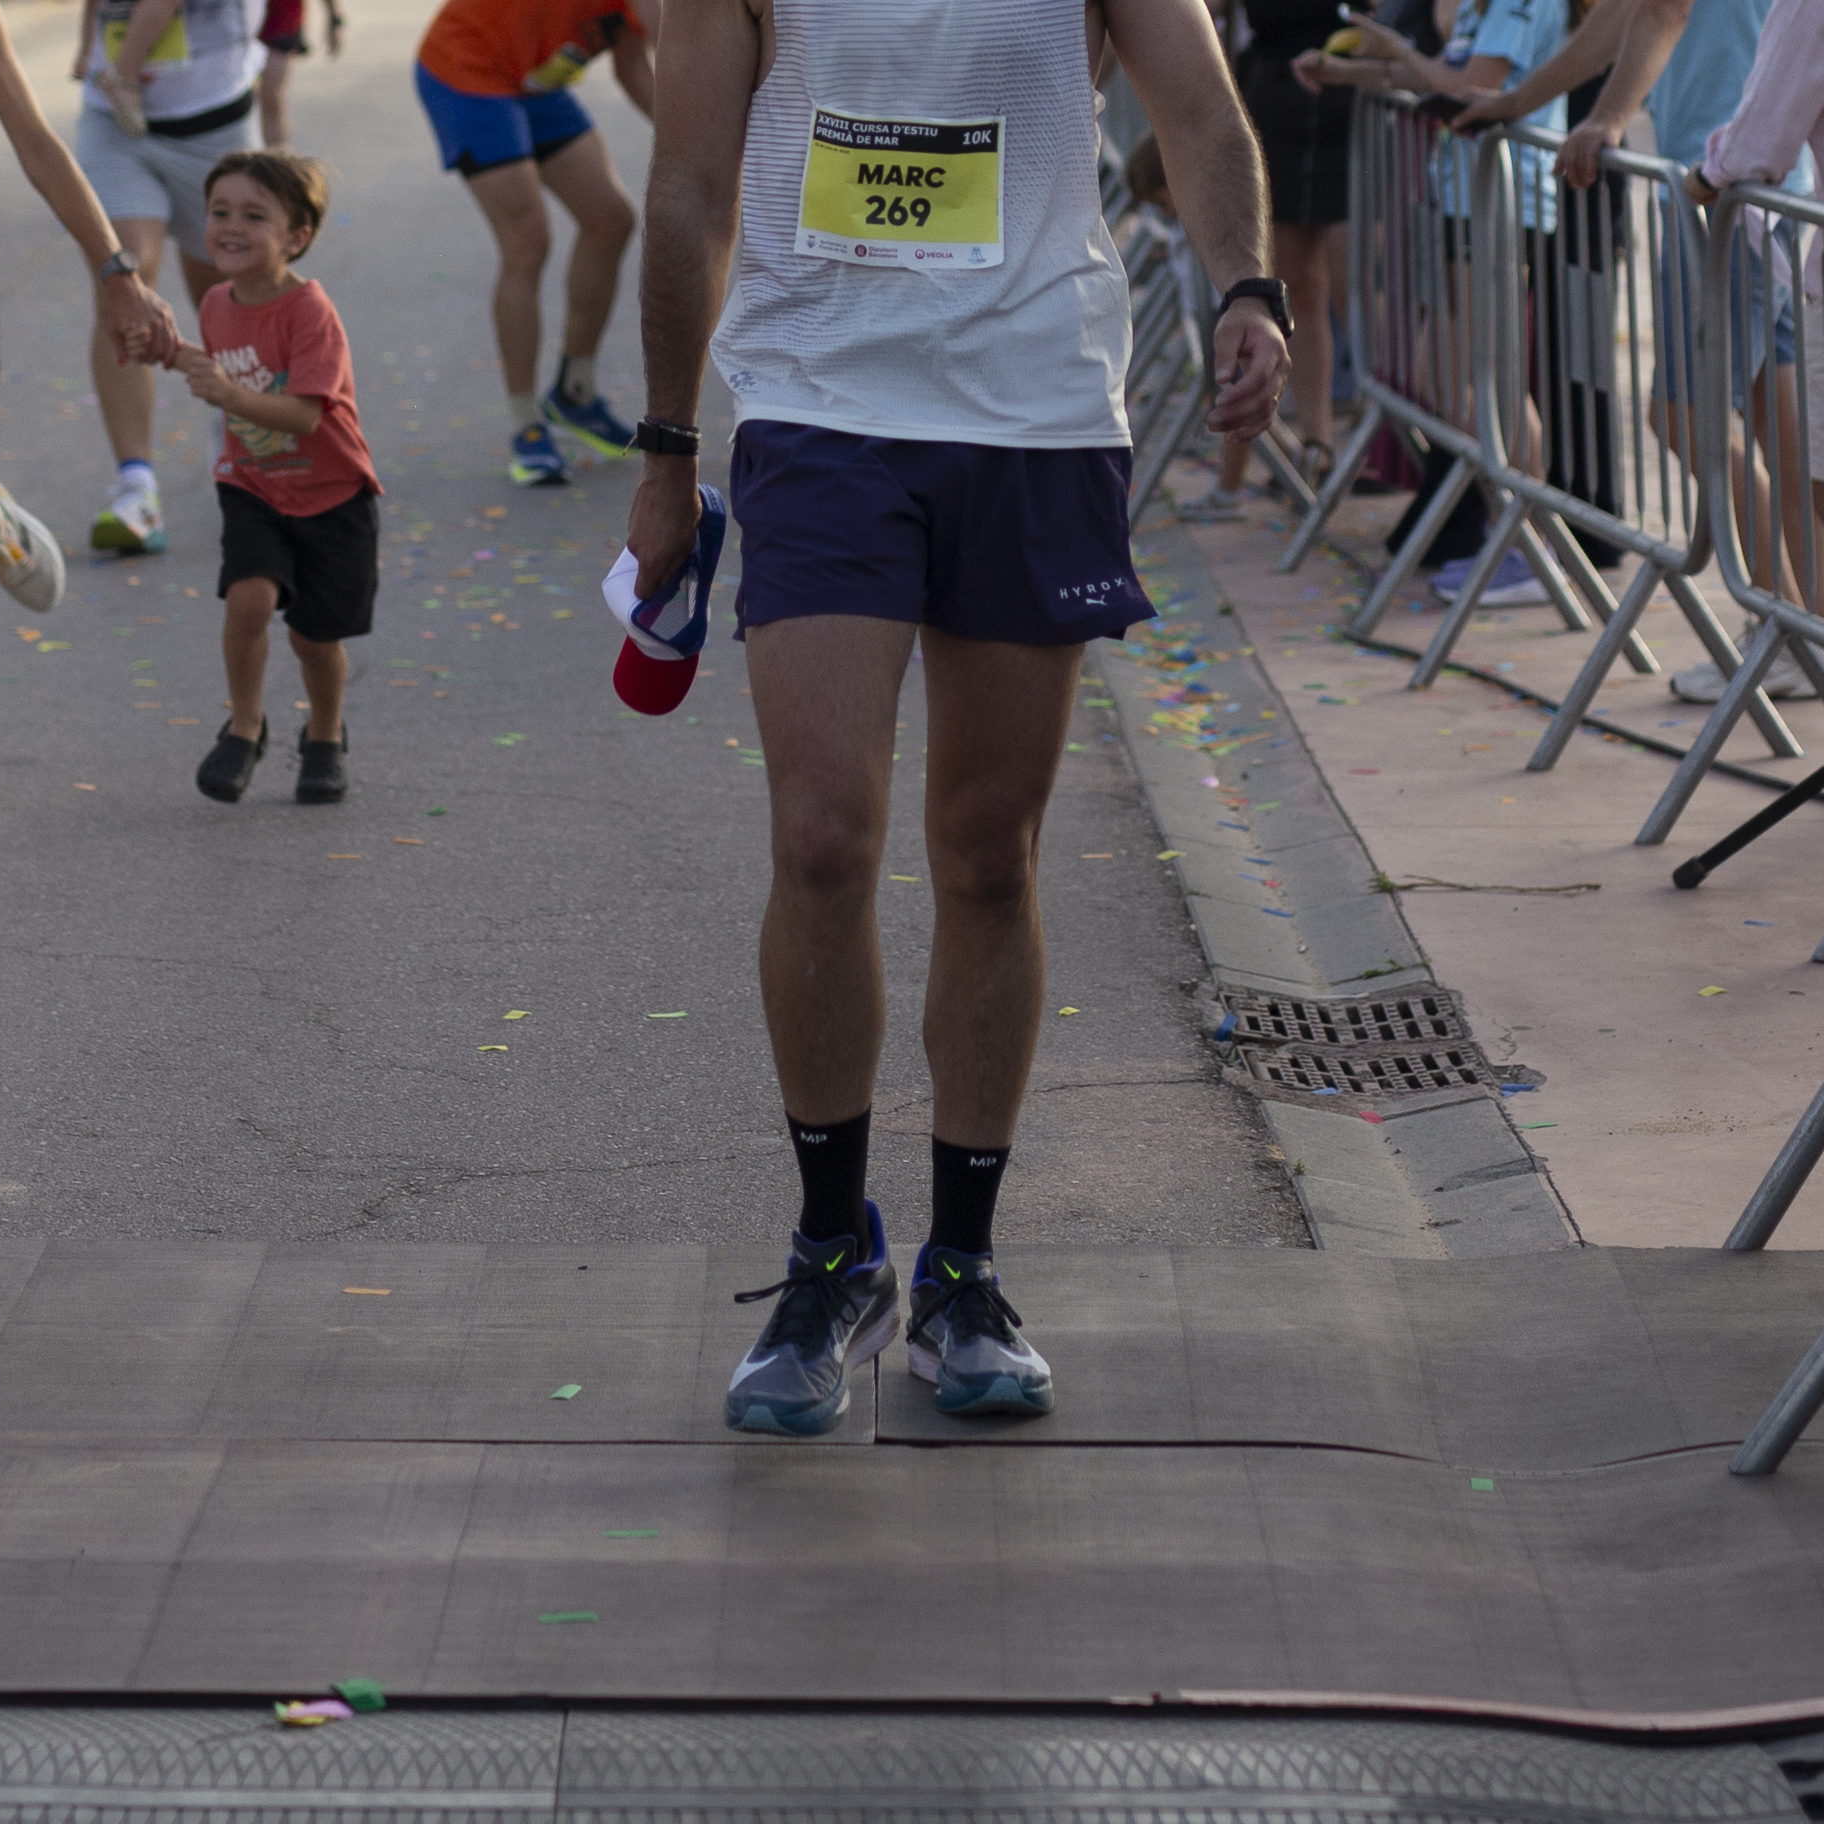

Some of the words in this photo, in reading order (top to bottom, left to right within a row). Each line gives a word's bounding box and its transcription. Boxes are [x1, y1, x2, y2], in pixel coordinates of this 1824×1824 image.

[816, 126, 854, 143] PREMIÀ
[856, 135, 871, 144] DE
[874, 136, 899, 146] MAR
[817, 114, 850, 130] XXVIII
[852, 122, 890, 133] CURSA
[892, 124, 939, 137] D'ESTIU
[962, 129, 992, 145] 10K
[857, 163, 947, 189] MARC
[865, 194, 932, 227] 269
[1059, 578, 1125, 599] HYROX
[800, 1131, 828, 1144] MP
[969, 1156, 997, 1167] MP
